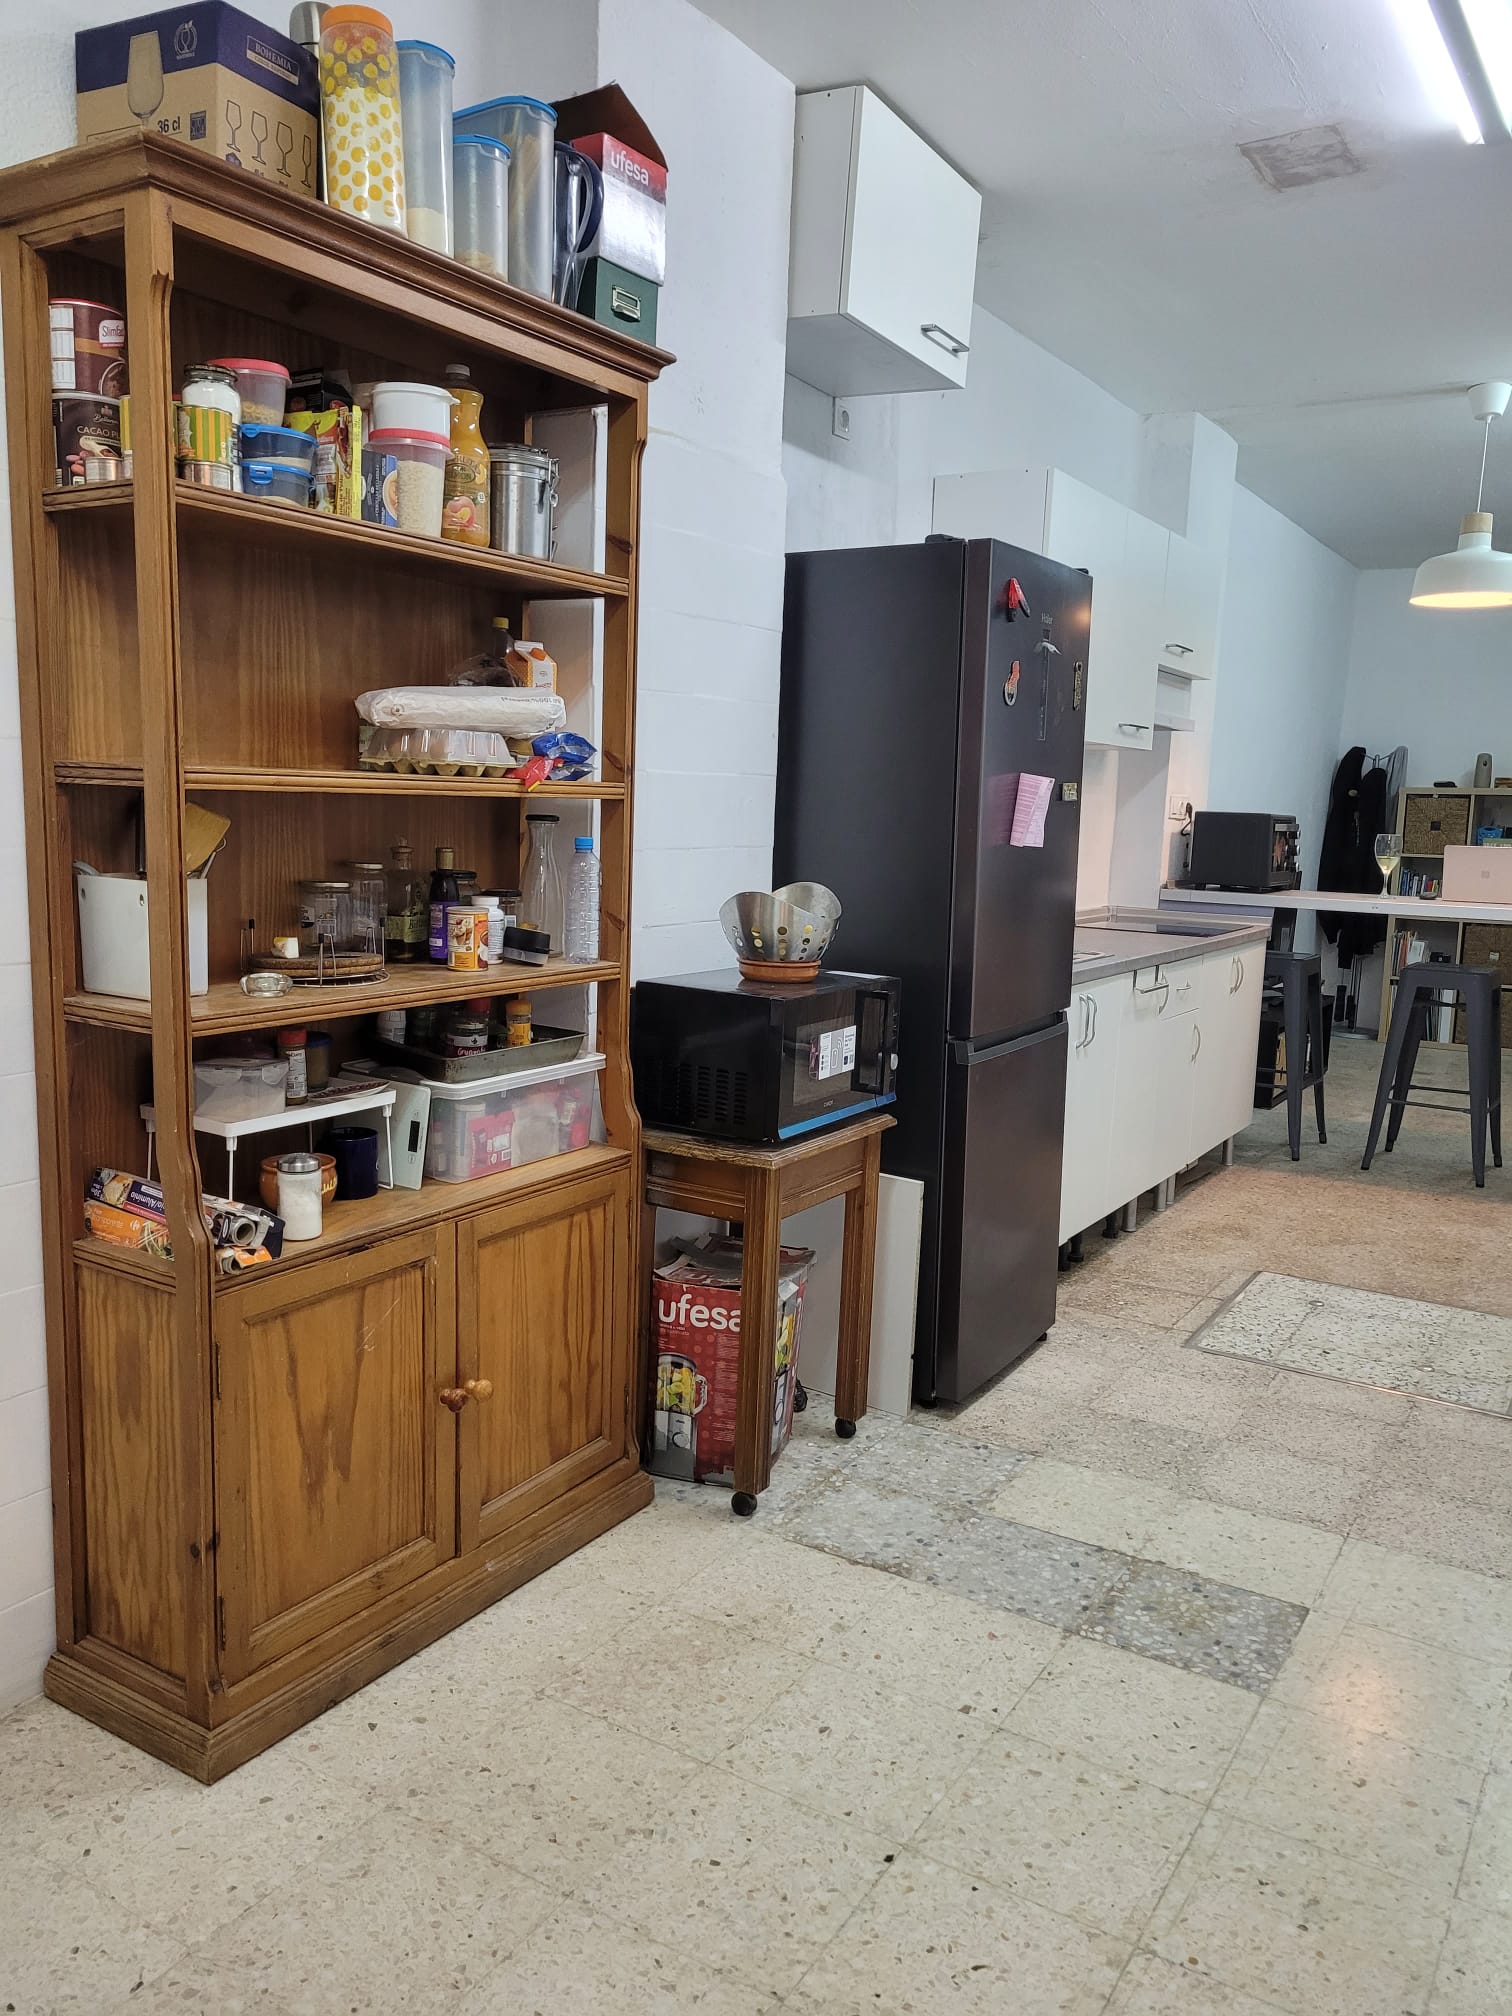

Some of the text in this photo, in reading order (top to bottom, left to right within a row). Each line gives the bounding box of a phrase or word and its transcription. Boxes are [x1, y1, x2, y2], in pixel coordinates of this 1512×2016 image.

[255, 42, 292, 71] BOHEMIA
[157, 118, 169, 133] 36
[172, 116, 181, 131] cl
[610, 150, 649, 186] ufesa
[77, 425, 110, 437] CACAO
[658, 1293, 741, 1333] ufesa
